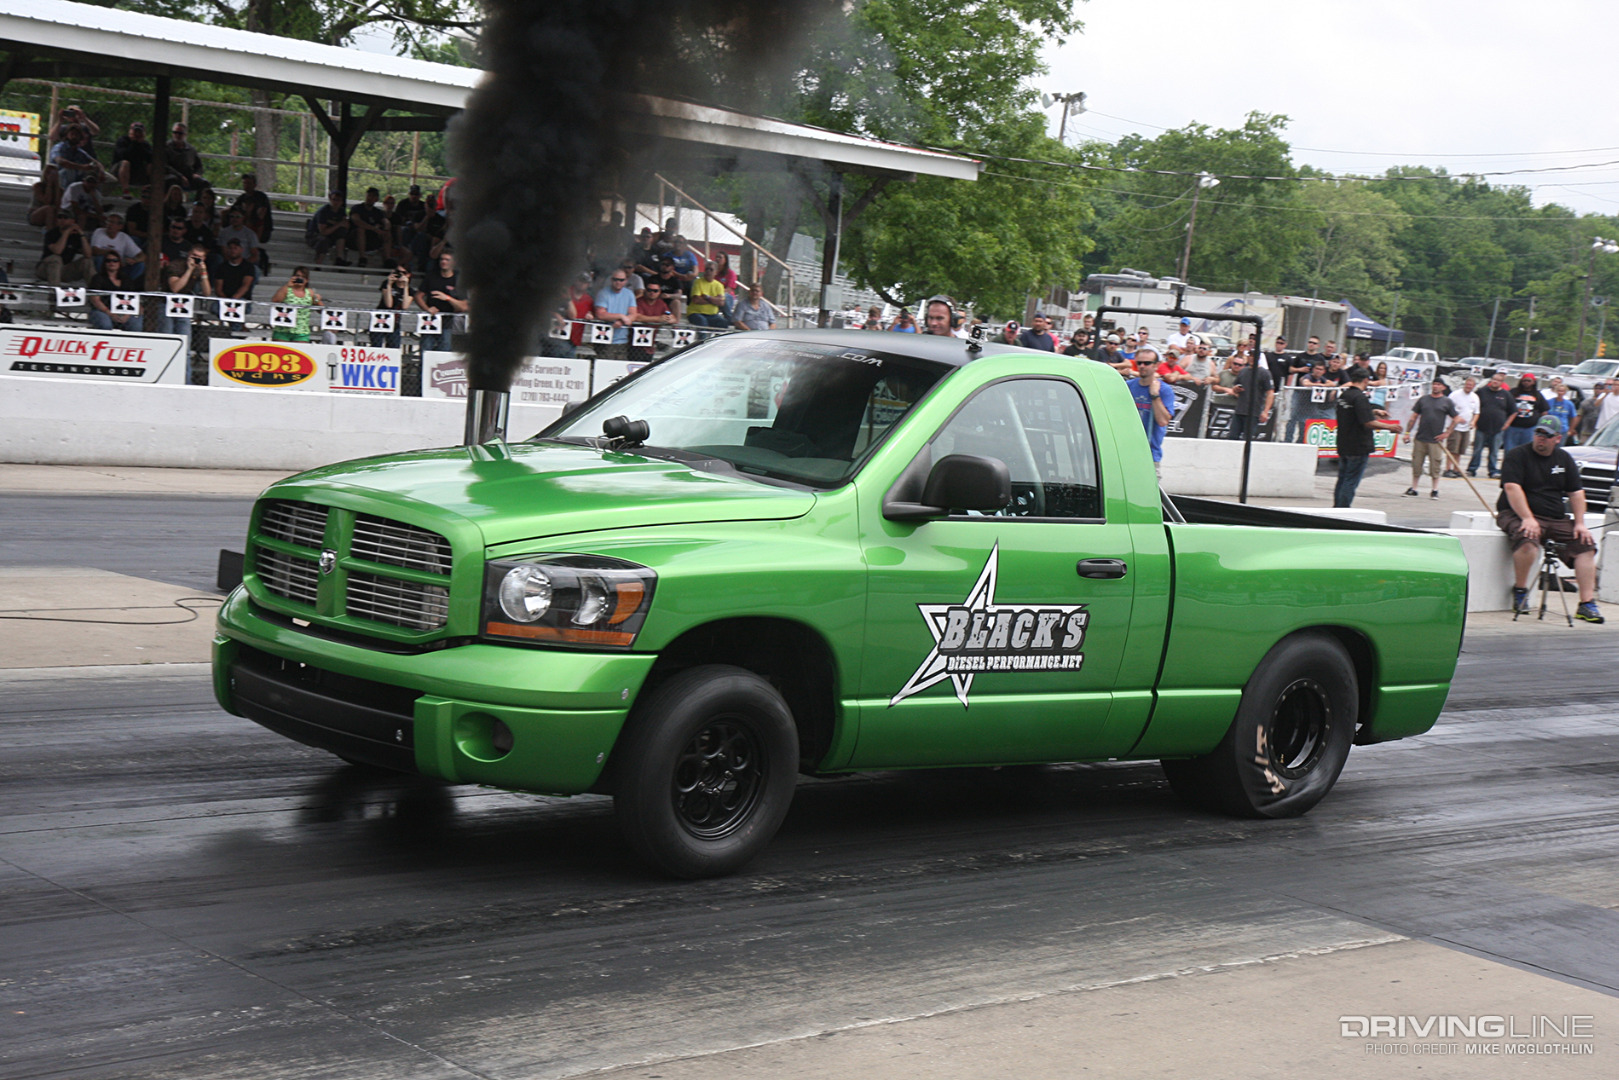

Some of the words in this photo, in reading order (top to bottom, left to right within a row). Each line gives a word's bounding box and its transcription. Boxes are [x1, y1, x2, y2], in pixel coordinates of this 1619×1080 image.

[18, 336, 89, 359] QUICK
[17, 363, 142, 376] TECHNOLOGY
[232, 351, 301, 373] D93
[535, 365, 563, 375] Corvette
[564, 366, 572, 375] Dr
[341, 363, 399, 389] WKCT
[566, 380, 585, 390] 42101
[939, 609, 1087, 650] BLACK'S
[987, 654, 1083, 670] PERFORMANCE.NET
